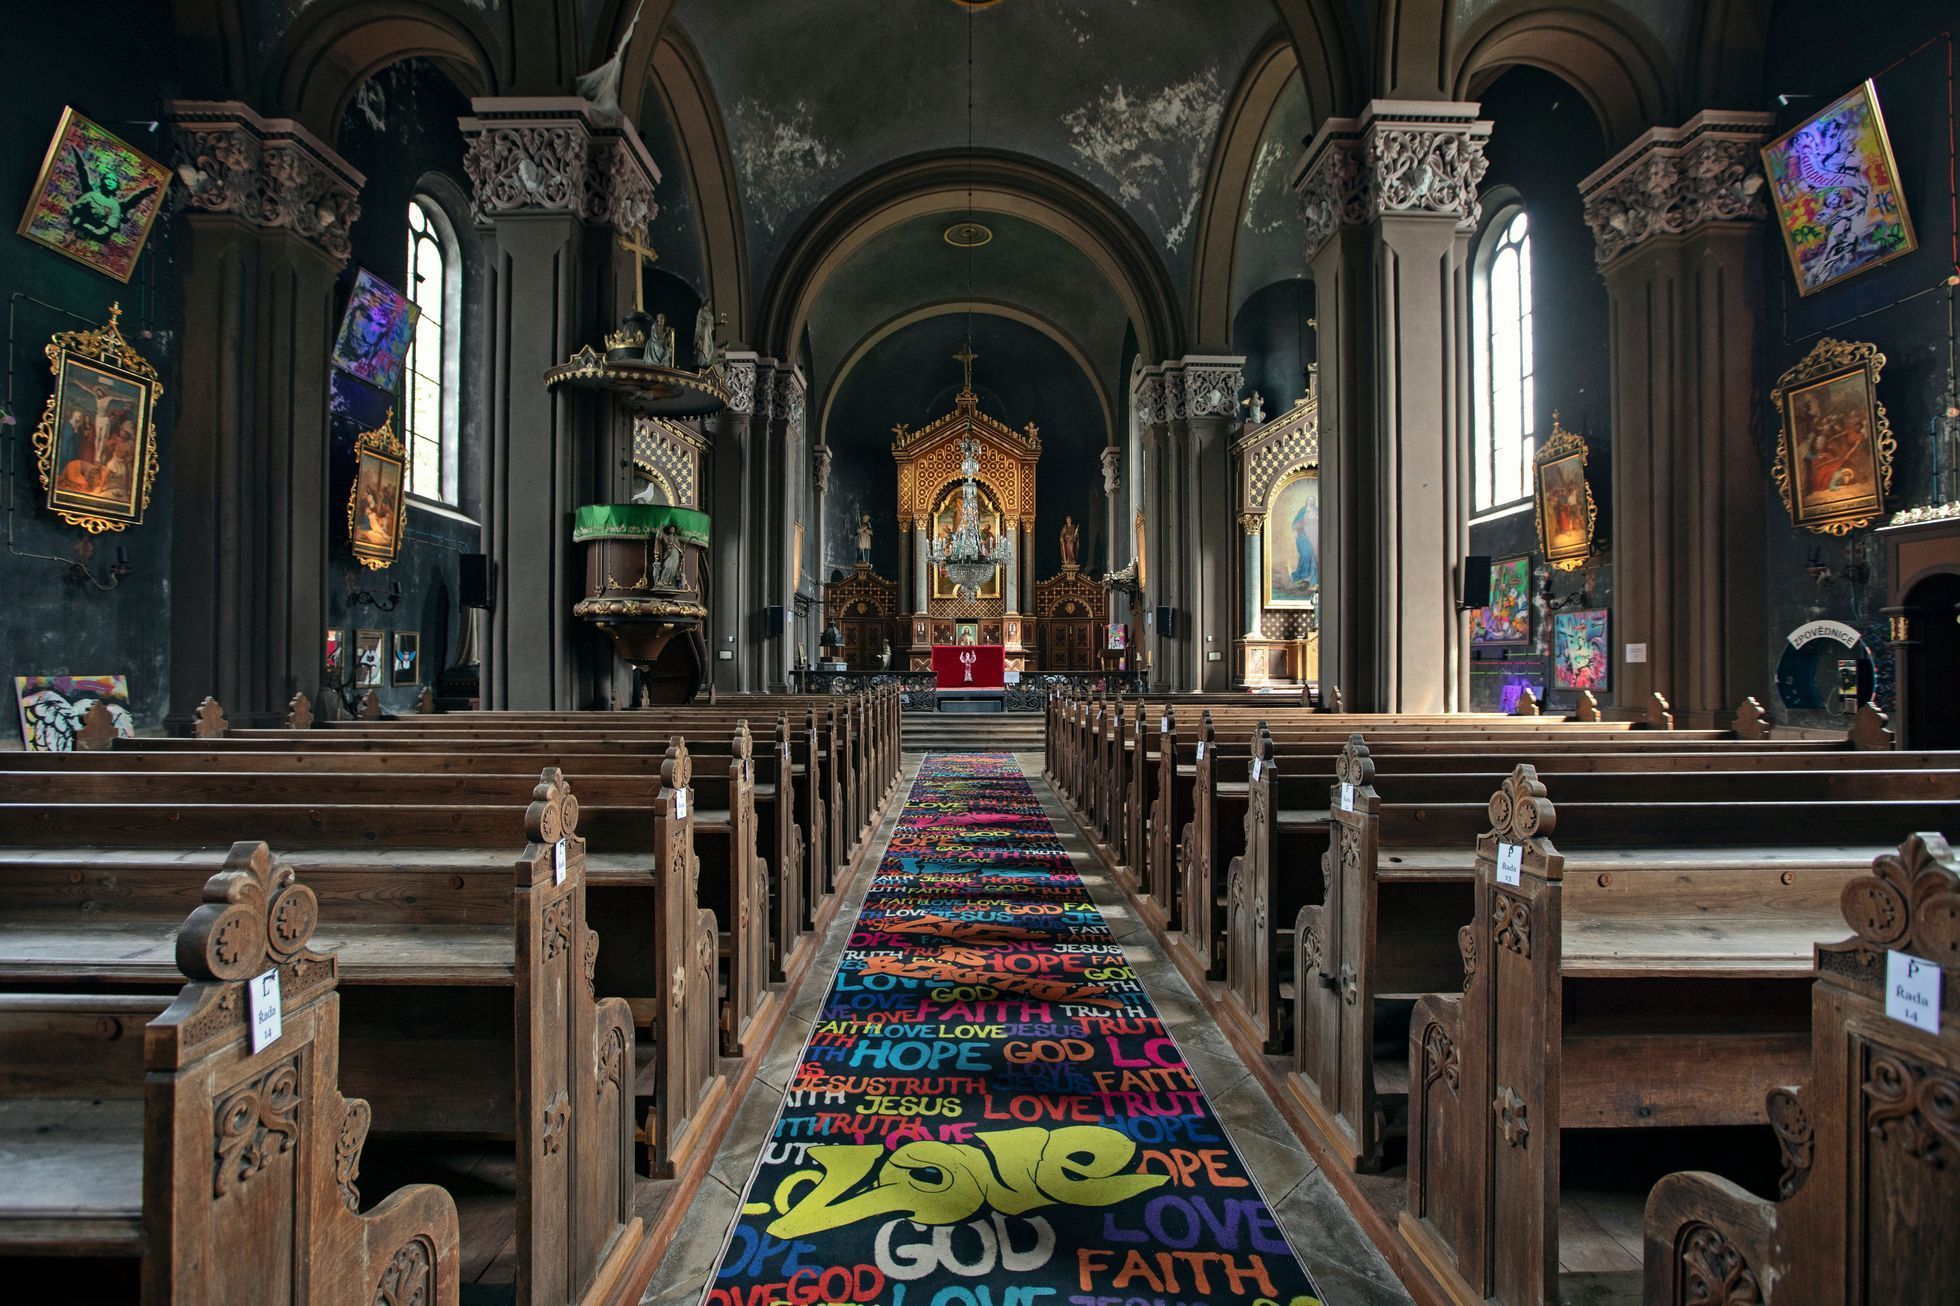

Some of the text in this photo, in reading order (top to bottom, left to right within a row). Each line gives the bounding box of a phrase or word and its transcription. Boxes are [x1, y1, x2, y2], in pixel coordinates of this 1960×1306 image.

[1792, 625, 1855, 647] ZPOVĚDNICE
[981, 876, 1037, 884] HOPE
[885, 909, 929, 917] LOVE
[928, 910, 1015, 922] JESUS
[1004, 904, 1064, 915] GOD
[848, 931, 913, 947] OPE
[1053, 943, 1123, 954] JESUS
[974, 953, 1087, 973] HOPE
[830, 992, 918, 1010] LOVE
[930, 986, 999, 1002] GOD
[852, 1009, 921, 1026] LOVE
[917, 999, 1054, 1024] FAITH
[939, 1024, 1009, 1039] LOVE
[1002, 1022, 1088, 1040] JESUS
[848, 1039, 993, 1071] HOPE
[1002, 1038, 1095, 1064] GOD
[791, 1074, 888, 1095] JESUS
[884, 1076, 988, 1096] TRUTH
[855, 1095, 963, 1117] JESUS
[984, 1094, 1102, 1122] LOVE
[813, 1111, 923, 1138] TRUTH
[1103, 1194, 1294, 1255] LOVE
[874, 1210, 1057, 1280] GOD
[1076, 1248, 1279, 1298] FAITH
[786, 1263, 886, 1306] GOD
